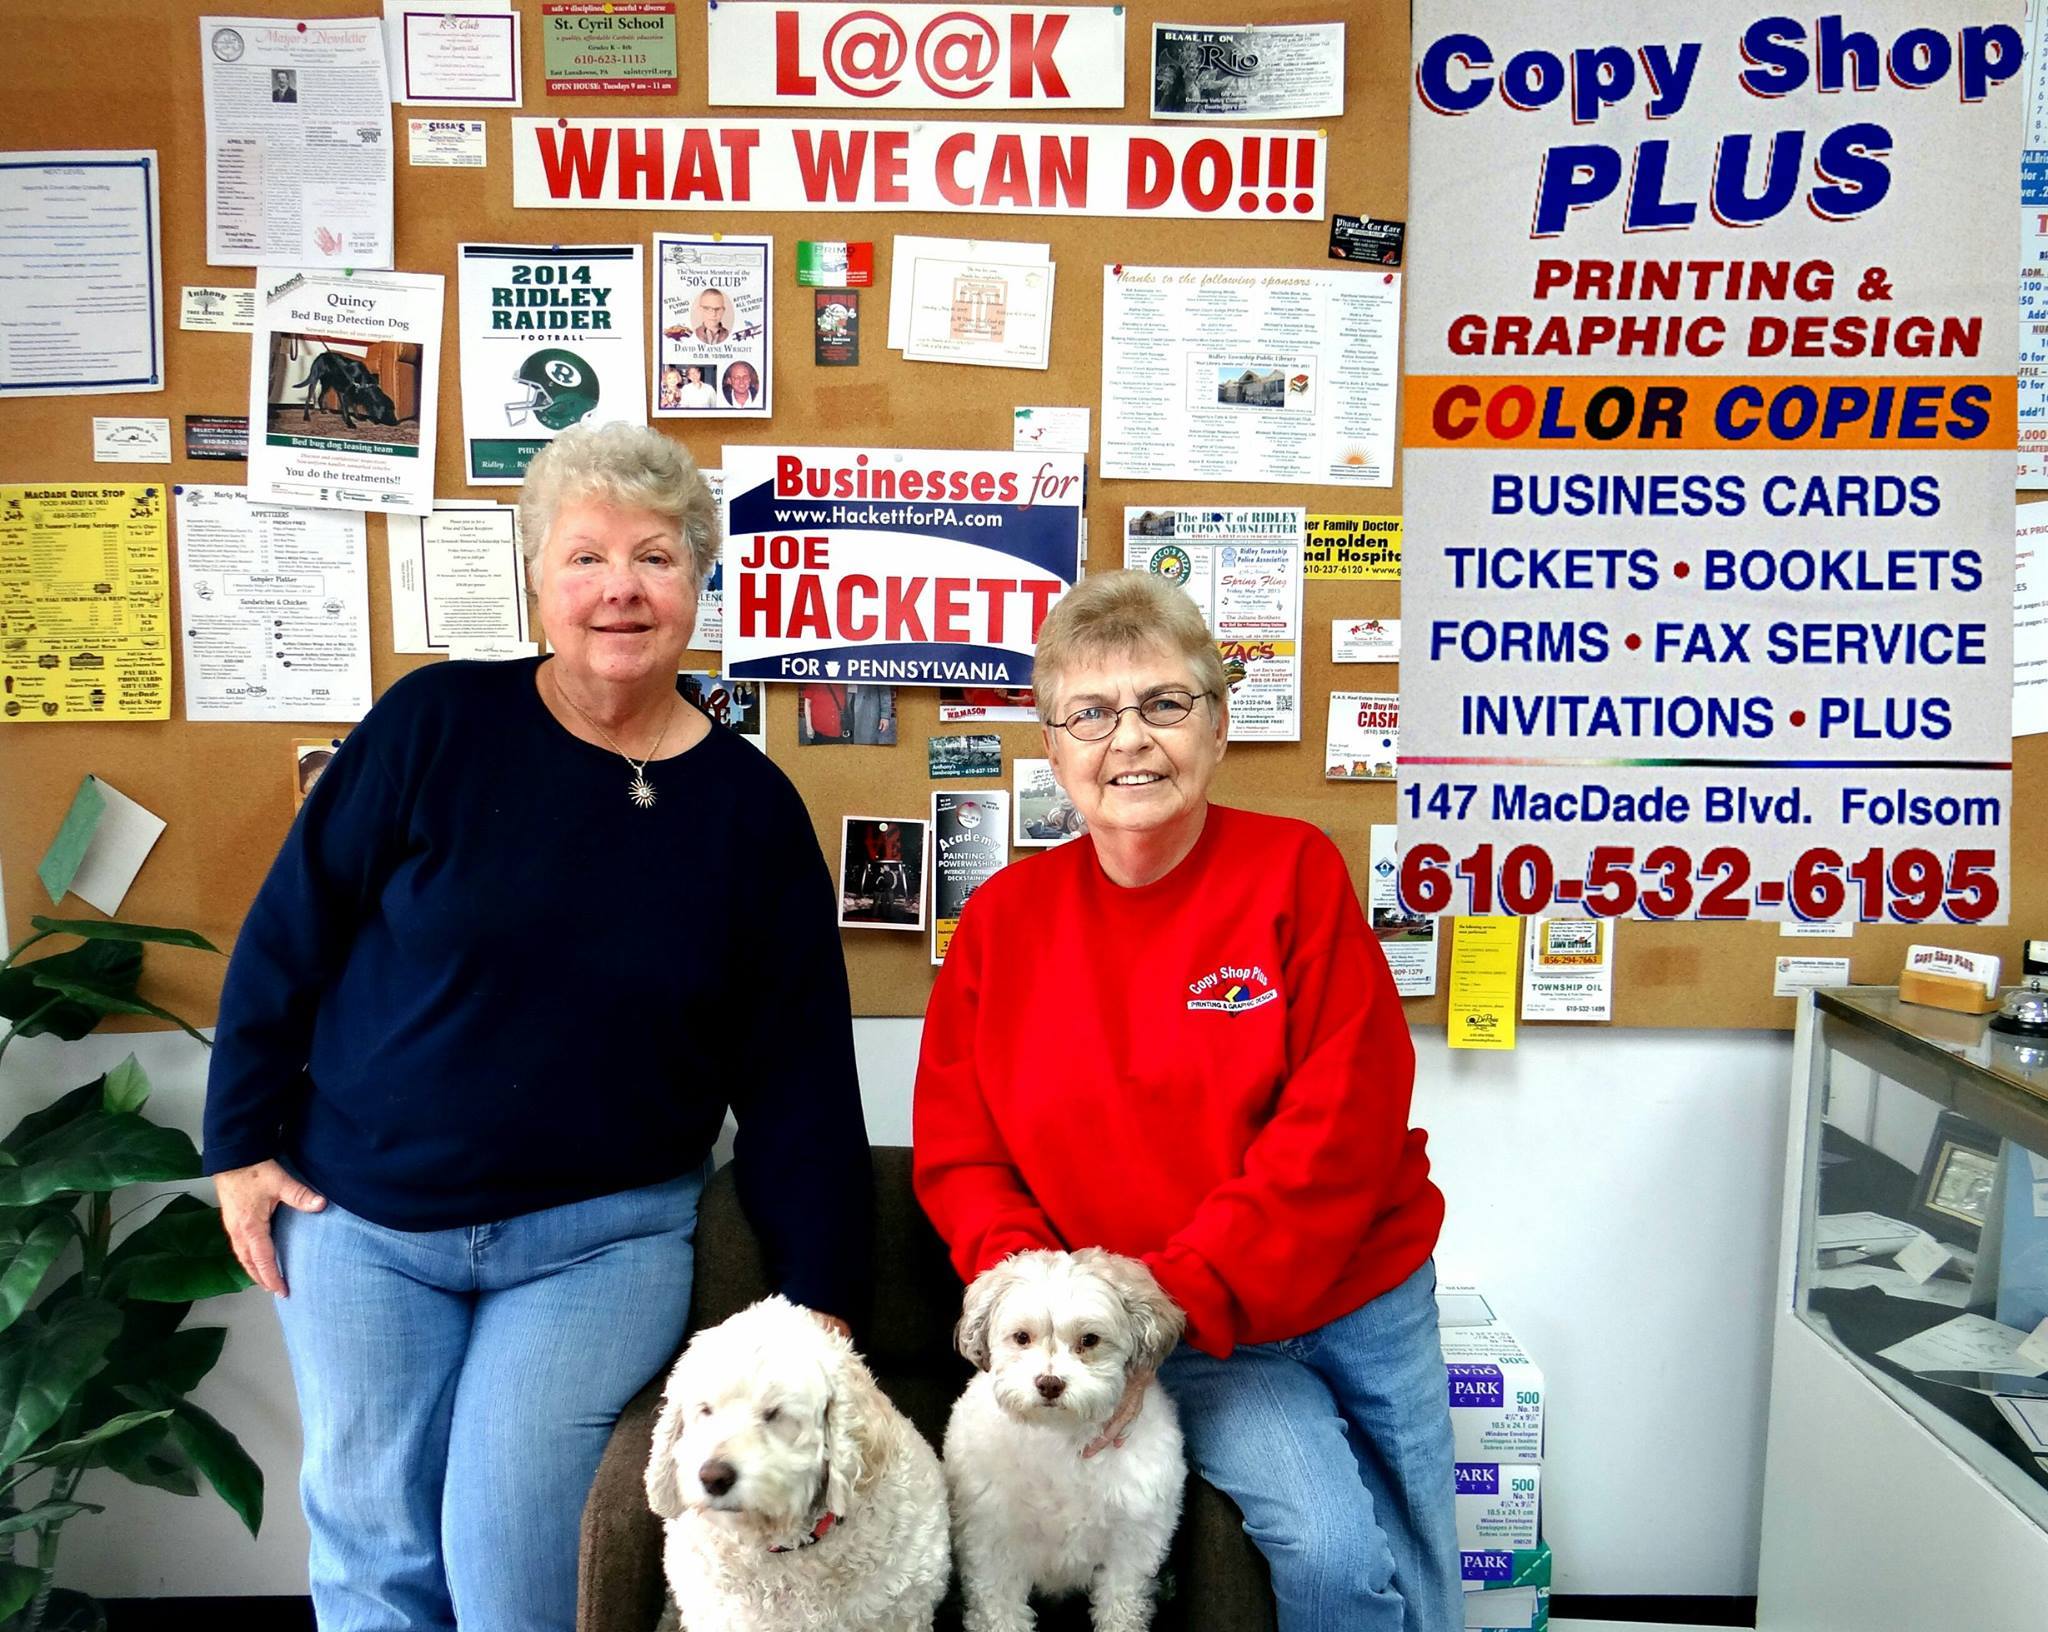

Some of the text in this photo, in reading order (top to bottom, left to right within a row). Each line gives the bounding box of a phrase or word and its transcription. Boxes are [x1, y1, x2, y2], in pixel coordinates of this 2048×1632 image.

[554, 17, 665, 33] St. Cyril School
[311, 31, 368, 45] Newsletter
[1165, 32, 1234, 43] BLAME IT ON
[574, 54, 647, 64] 610-623-1113
[774, 11, 1071, 102] L@@K
[1199, 44, 1260, 78] Rio
[1416, 34, 1702, 125] Copy
[1740, 15, 2023, 103] Shop
[552, 82, 572, 90] OPEN
[428, 121, 466, 133] SESSA'S
[535, 127, 1316, 214] WHAT WE CAN DO!!!
[1530, 123, 1893, 239] PLUS
[1336, 218, 1401, 233] Phase Car Care
[511, 265, 591, 285] 2014
[709, 276, 747, 287] CLUB"
[1116, 271, 1312, 288] Thanks to the following sponsors
[1534, 260, 1893, 301] PRINTING &
[327, 293, 377, 311] Quincy
[492, 287, 612, 308] RIDLEY
[664, 296, 681, 304] STILL
[733, 294, 751, 302] AFTER
[669, 301, 690, 310] FLYING
[674, 308, 689, 316] HIGH
[291, 310, 409, 330] Bed Bug Detection Dog
[492, 310, 612, 330] RAIDER
[1448, 316, 1983, 357] GRAPHIC DESIGN
[674, 344, 752, 352] DAVID WAYNE WRIGHT
[1432, 386, 1993, 441] COLOR COPIES
[292, 438, 307, 446] Bed
[310, 438, 324, 449] bug
[327, 440, 342, 451] dog
[344, 441, 372, 453] leasing
[482, 461, 504, 469] Ridley
[286, 467, 401, 485] You do the treatments!!
[777, 454, 1080, 510] Businesses for
[71, 490, 98, 498] QUICK
[103, 489, 125, 498] STOP
[1492, 475, 1941, 518] BUSINESS CARDS
[250, 511, 290, 519] APPETIZERS
[774, 505, 1002, 528] www.HackettforPA.com
[1175, 511, 1299, 524] The BT of RIDLEY
[1176, 524, 1298, 534] COUPON NEWSLETTER
[1323, 519, 1359, 532] Family
[1306, 533, 1389, 548] lenolden
[741, 536, 830, 570] JOE
[1240, 547, 1287, 556] Ridley Township
[1151, 547, 1176, 573] COCCO'S
[1304, 565, 1363, 574] 610-237-6120
[1444, 547, 1983, 591] TICKETS BOOKLETS
[1220, 574, 1287, 588] Spring Fling
[739, 573, 1063, 644] HACKETT
[1431, 621, 1987, 666] FORMS FAX SERVICE
[1220, 640, 1275, 664] ZAC'S
[781, 658, 1010, 682] FOR PENNSYLVANIA
[1360, 702, 1387, 711] We Buy
[1462, 697, 1951, 740] INVITATIONS PLUS
[1404, 783, 2001, 828] 147 MacDade Blvd. Folsom
[939, 829, 1001, 852] Academy
[943, 852, 985, 860] PAINTING
[938, 860, 1002, 868] POWERWASHING
[1398, 844, 2000, 923] 610-532-6195
[1550, 941, 1566, 949] LAWN
[1914, 952, 1933, 964] Copy
[1935, 950, 1953, 964] Shop
[1189, 966, 1268, 994] Copy Shop Plus
[1532, 983, 1583, 991] TOWNSHIP
[1228, 1001, 1254, 1009] GRAPHIC
[1255, 991, 1274, 1004] DESIGN
[1455, 1381, 1500, 1394] PARK
[1516, 1391, 1540, 1404] 500
[1518, 1405, 1530, 1413] No.
[1455, 1469, 1495, 1481] PARK
[1512, 1478, 1535, 1491] 500
[1513, 1492, 1535, 1500] No. 10
[1463, 1555, 1508, 1569] PARK
